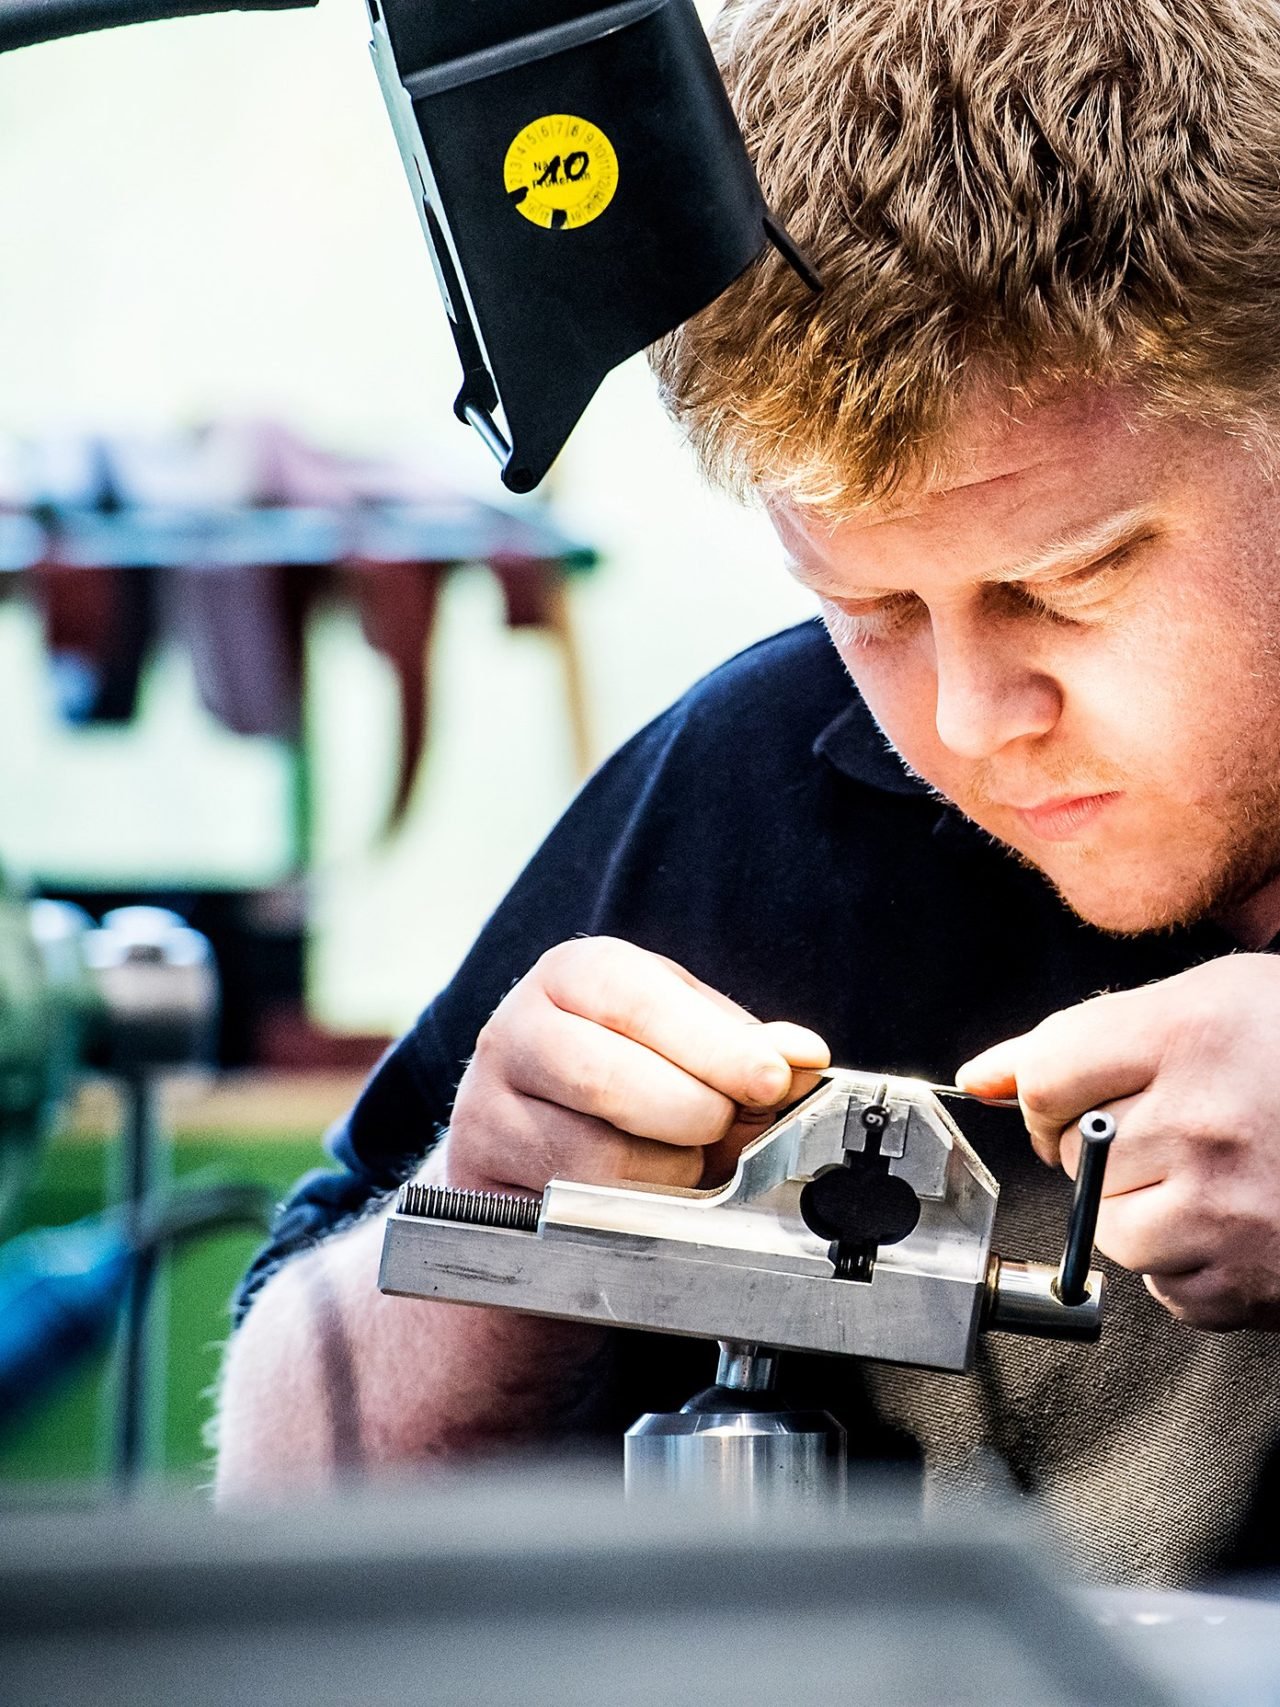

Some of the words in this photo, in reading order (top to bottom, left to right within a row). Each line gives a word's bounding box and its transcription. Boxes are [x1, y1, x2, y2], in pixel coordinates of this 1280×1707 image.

[517, 146, 527, 154] 4
[526, 133, 537, 145] 5
[540, 124, 550, 138] 6
[556, 120, 563, 134] 7
[570, 124, 580, 137] 8
[583, 132, 595, 145] 9
[592, 143, 607, 158] 10
[537, 151, 589, 185] 10
